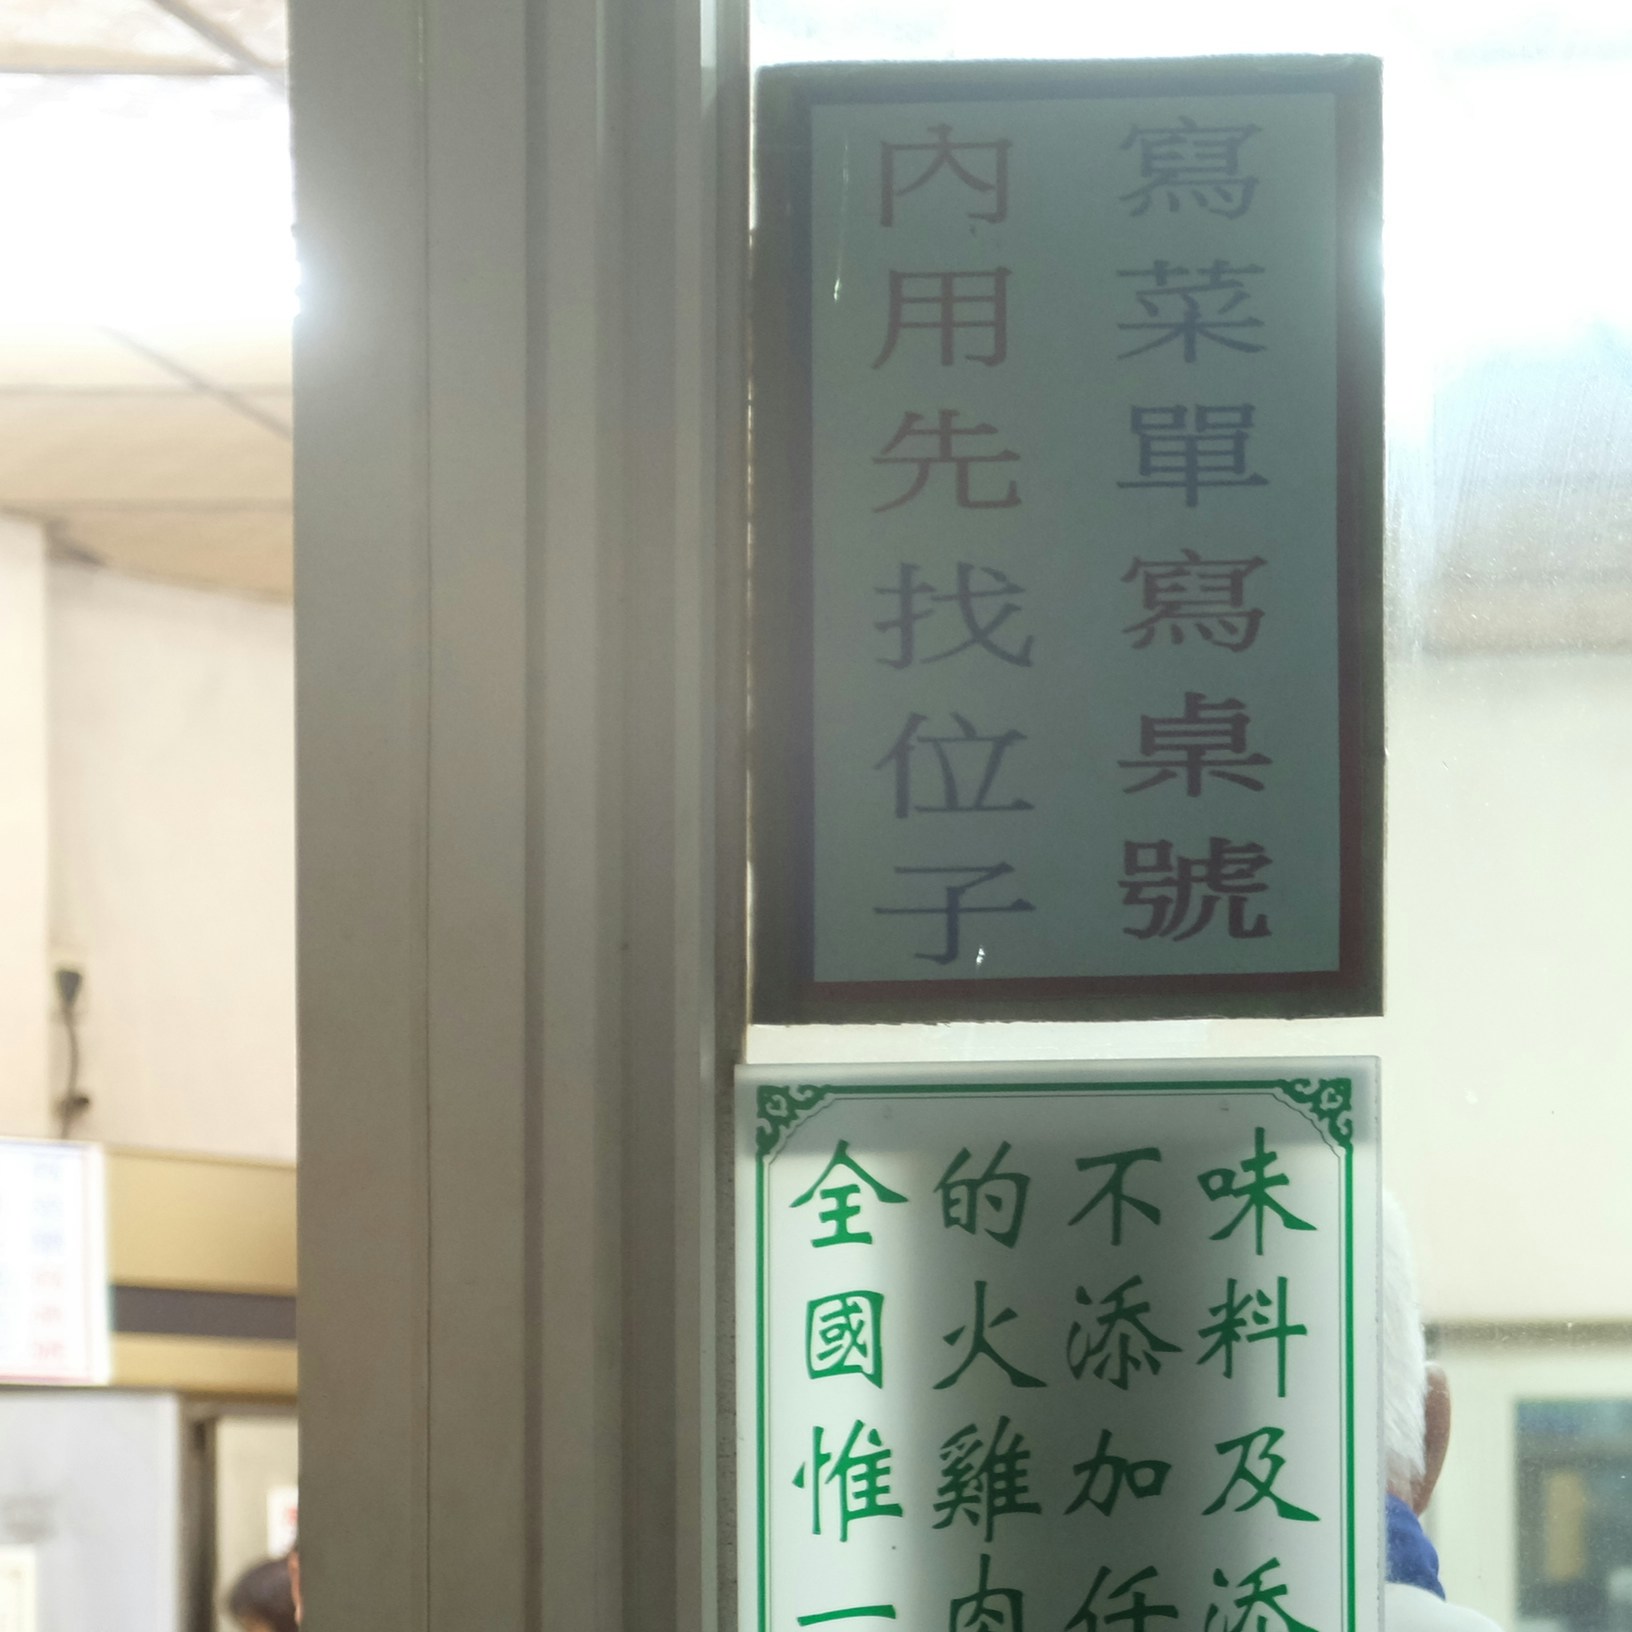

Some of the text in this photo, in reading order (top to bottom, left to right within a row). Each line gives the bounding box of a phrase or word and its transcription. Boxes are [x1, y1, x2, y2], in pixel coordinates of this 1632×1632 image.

[1115, 117, 1274, 943] 寫菜單寫桌號
